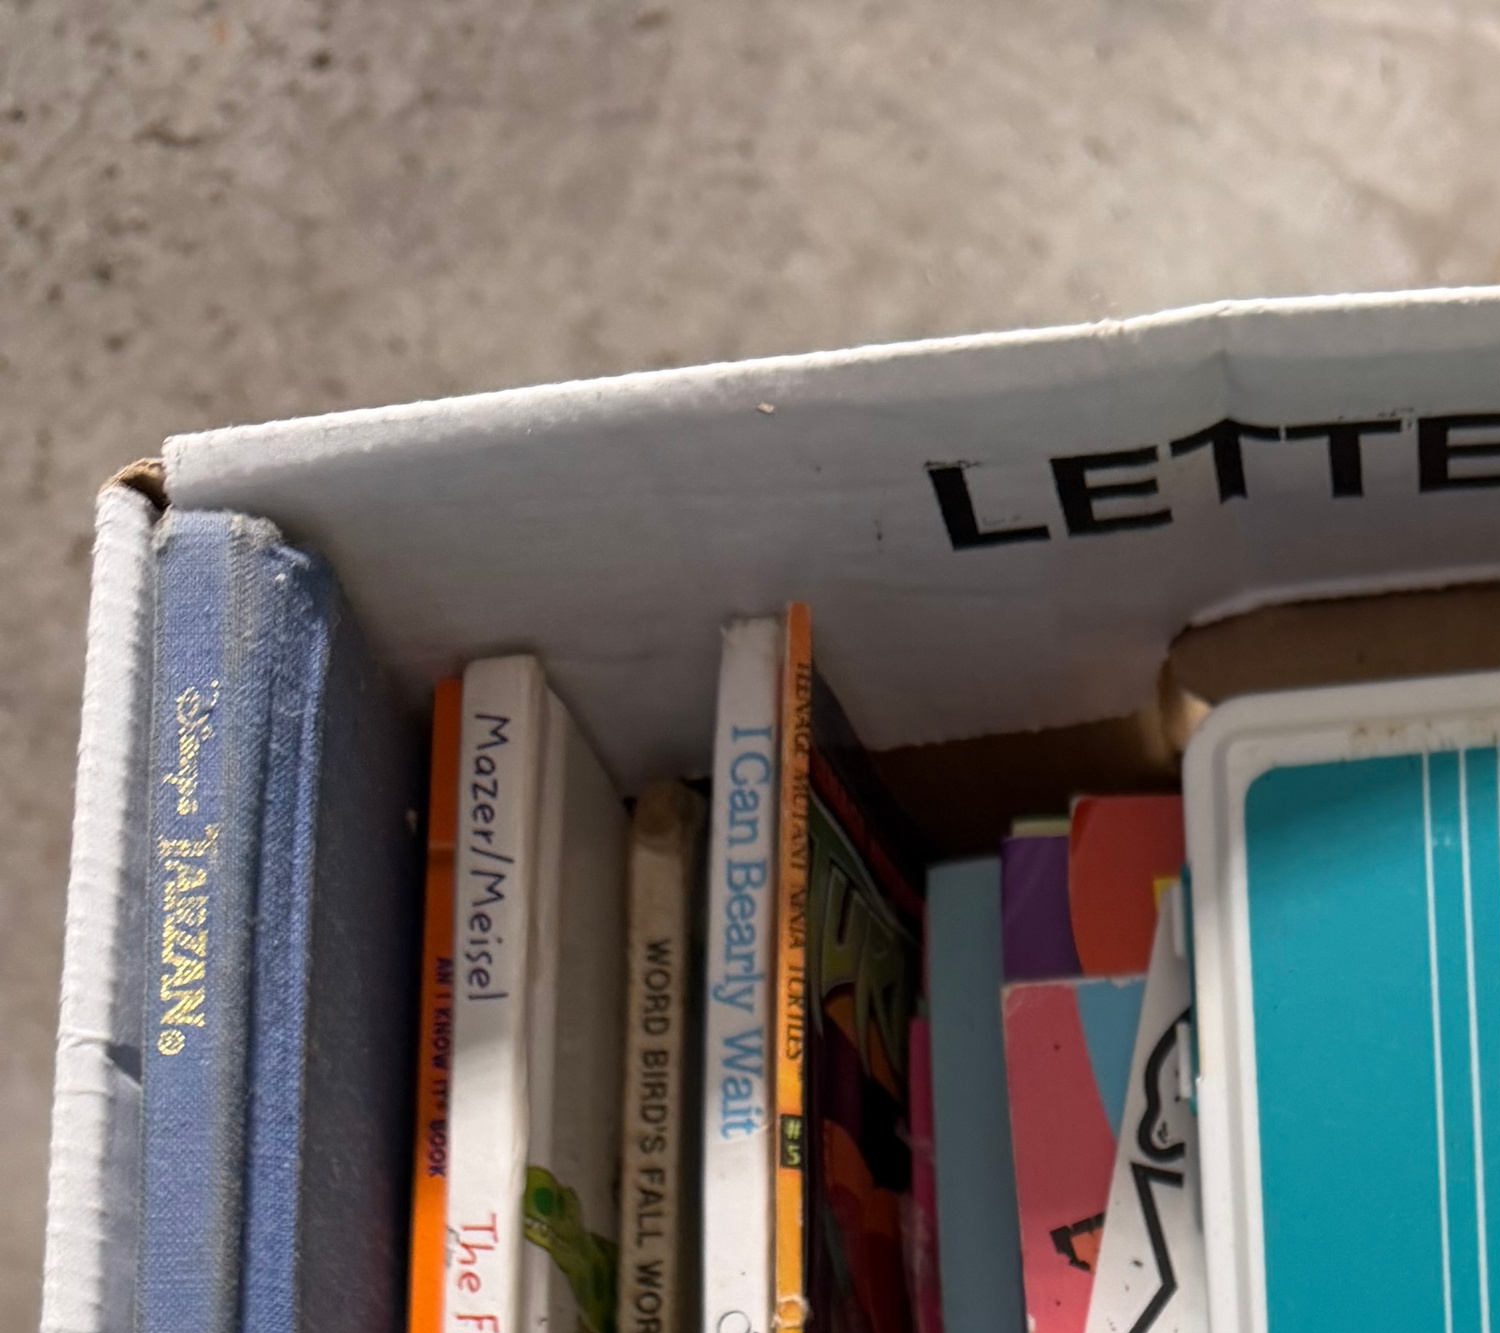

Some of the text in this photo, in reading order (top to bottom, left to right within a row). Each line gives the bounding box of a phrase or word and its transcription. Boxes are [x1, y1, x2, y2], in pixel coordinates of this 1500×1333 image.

[465, 713, 515, 1002] Mazer/Meisel
[712, 725, 773, 1141] I Can Bearly Wait
[787, 885, 808, 949] NINJA
[637, 938, 673, 1040] WORD
[430, 1007, 453, 1070] KNOW
[636, 1047, 670, 1152] BIRD'S
[426, 1118, 450, 1179] BOOK
[635, 1163, 669, 1249] FALL
[455, 1212, 499, 1295] The
